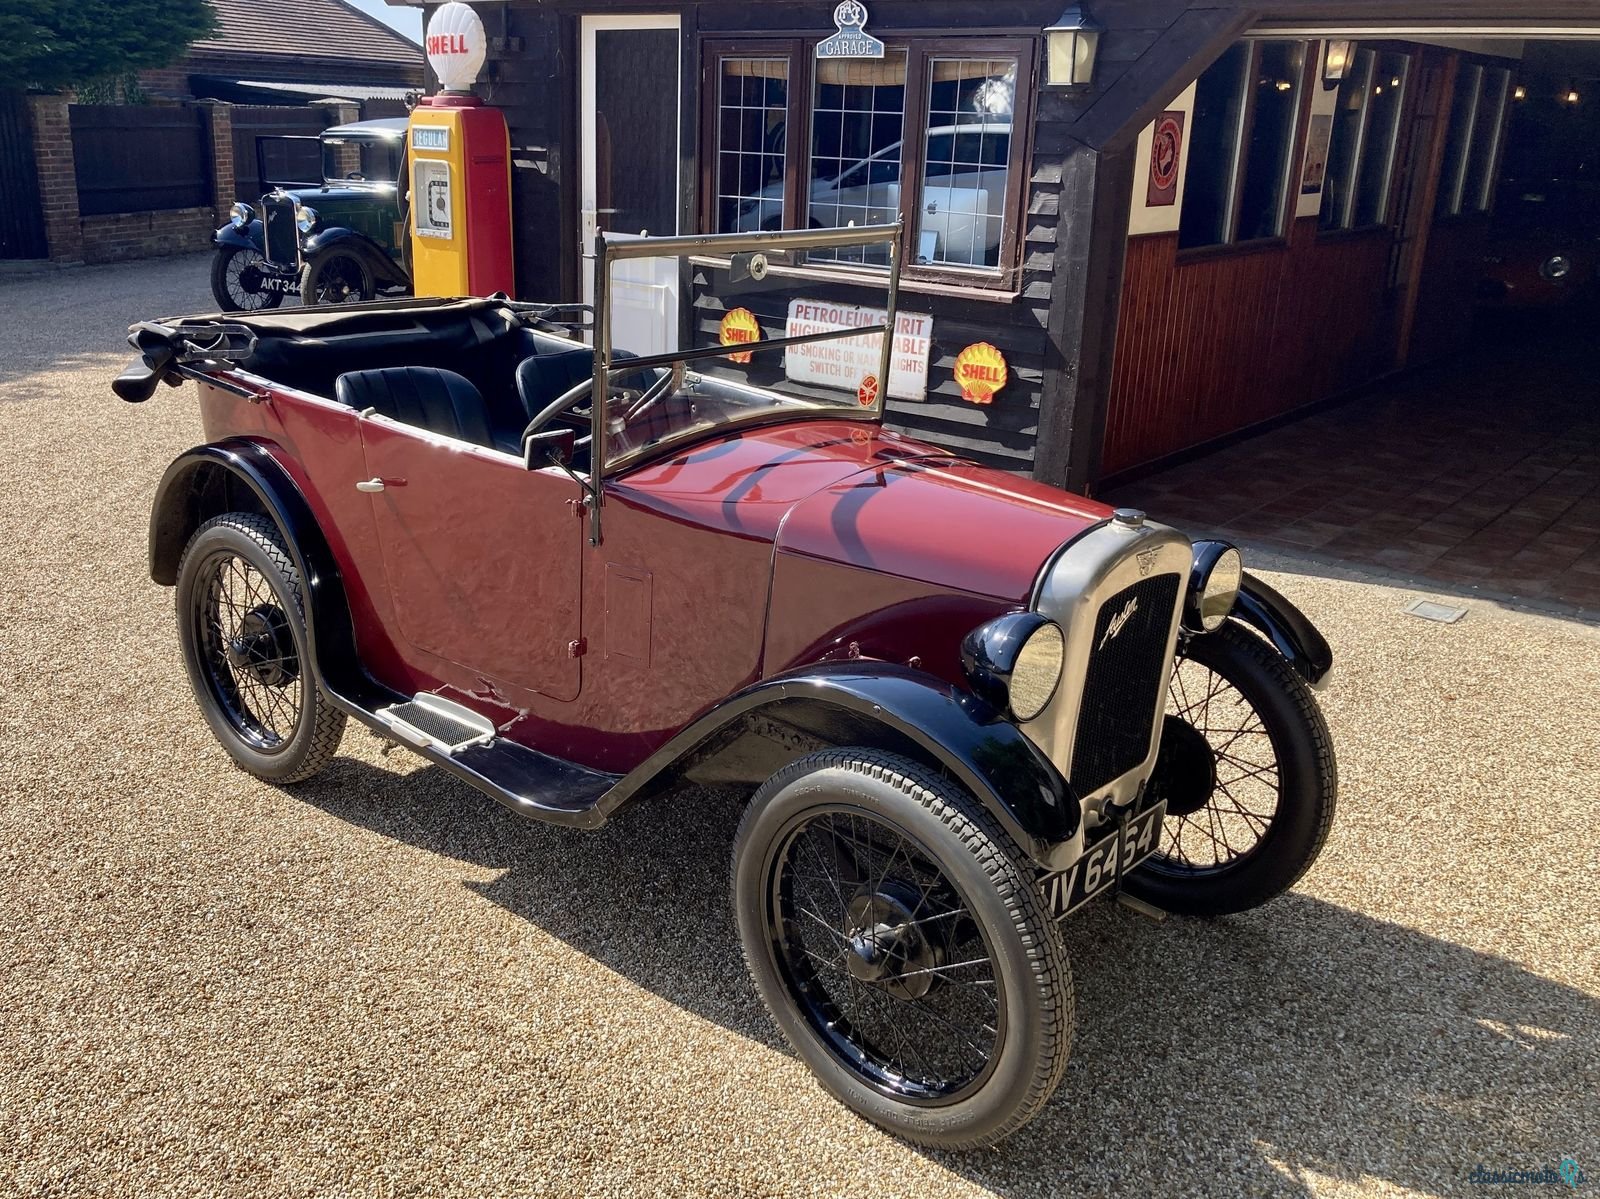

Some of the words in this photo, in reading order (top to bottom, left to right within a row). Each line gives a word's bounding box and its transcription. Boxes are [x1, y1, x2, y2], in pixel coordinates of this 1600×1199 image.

[427, 34, 469, 56] SHELL
[826, 41, 874, 55] GARAGE
[260, 277, 281, 291] AKT
[795, 304, 874, 327] PETROLEUM
[878, 314, 925, 336] SIRIT
[725, 327, 753, 344] SHELL
[800, 344, 841, 361] SMOKING
[809, 360, 841, 377] SWITCH
[961, 363, 999, 383] SHELL
